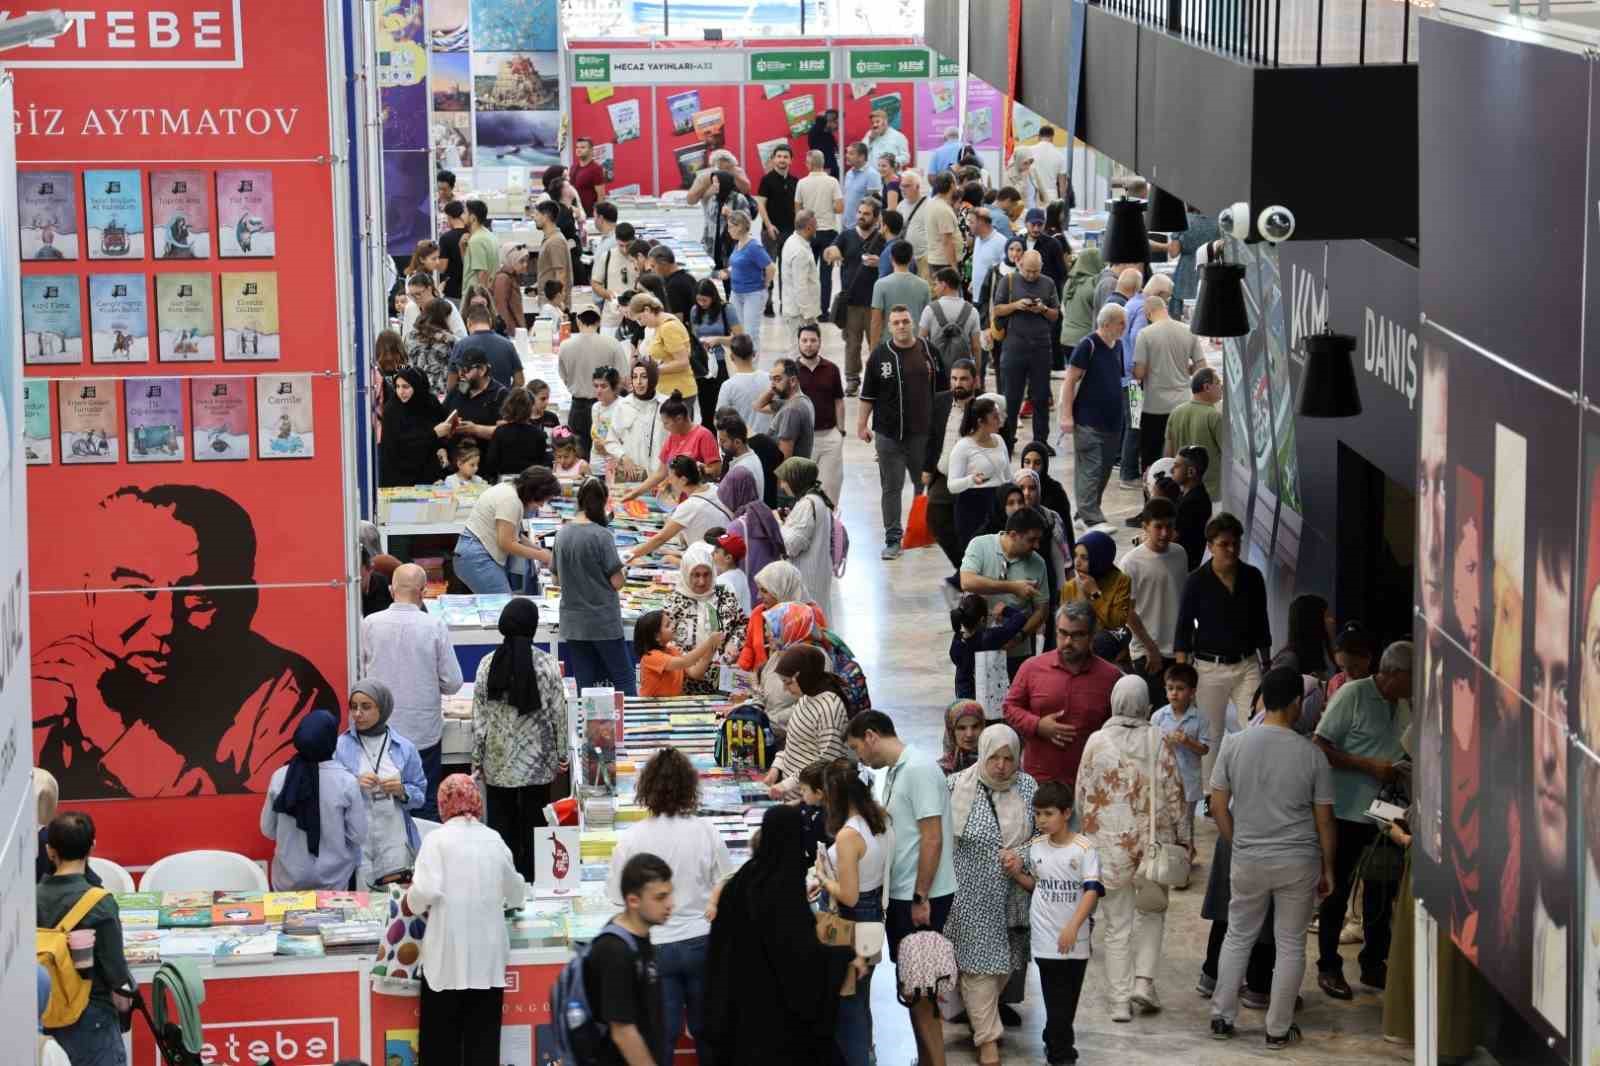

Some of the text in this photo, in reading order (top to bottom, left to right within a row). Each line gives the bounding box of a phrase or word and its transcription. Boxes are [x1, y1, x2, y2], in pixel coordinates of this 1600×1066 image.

[0, 11, 222, 48] TEBE
[80, 108, 300, 136] AYTMATOV
[1364, 306, 1417, 410] DANIŞ
[1038, 876, 1082, 891] mirates
[200, 1031, 328, 1064] etebe
